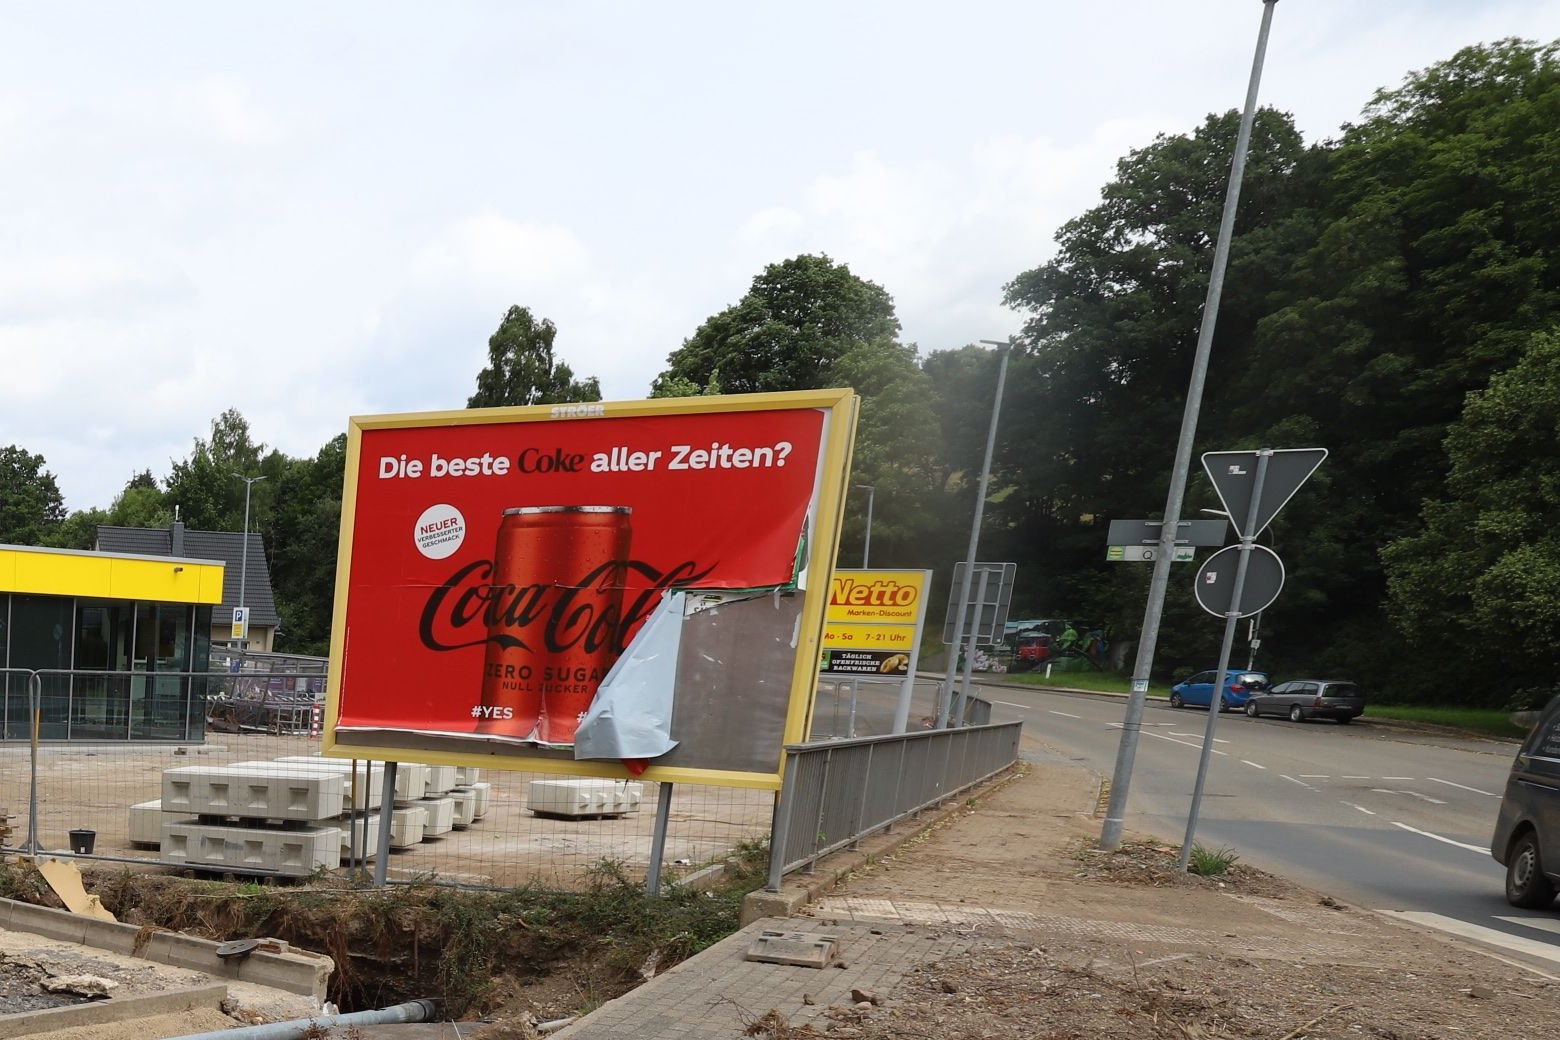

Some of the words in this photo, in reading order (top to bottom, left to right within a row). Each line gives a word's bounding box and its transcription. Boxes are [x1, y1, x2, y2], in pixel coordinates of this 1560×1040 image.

[551, 404, 604, 419] STRÖER
[378, 454, 423, 479] Die
[430, 451, 511, 477] beste
[518, 447, 585, 474] Coke
[590, 446, 662, 473] aller
[668, 440, 793, 470] Zeiten?
[420, 517, 458, 535] NEUER
[417, 526, 463, 543] VERBESSERTER
[422, 534, 460, 548] GESCHMACK
[830, 578, 918, 607] Netto
[236, 611, 242, 621] P
[847, 609, 912, 617] Marken-Discount
[842, 632, 853, 640] Sa
[890, 634, 906, 642] Uhr
[487, 663, 533, 680] ZERO
[502, 681, 533, 692] NULL
[539, 683, 589, 694] ZUCKER
[471, 706, 514, 720] #YES
